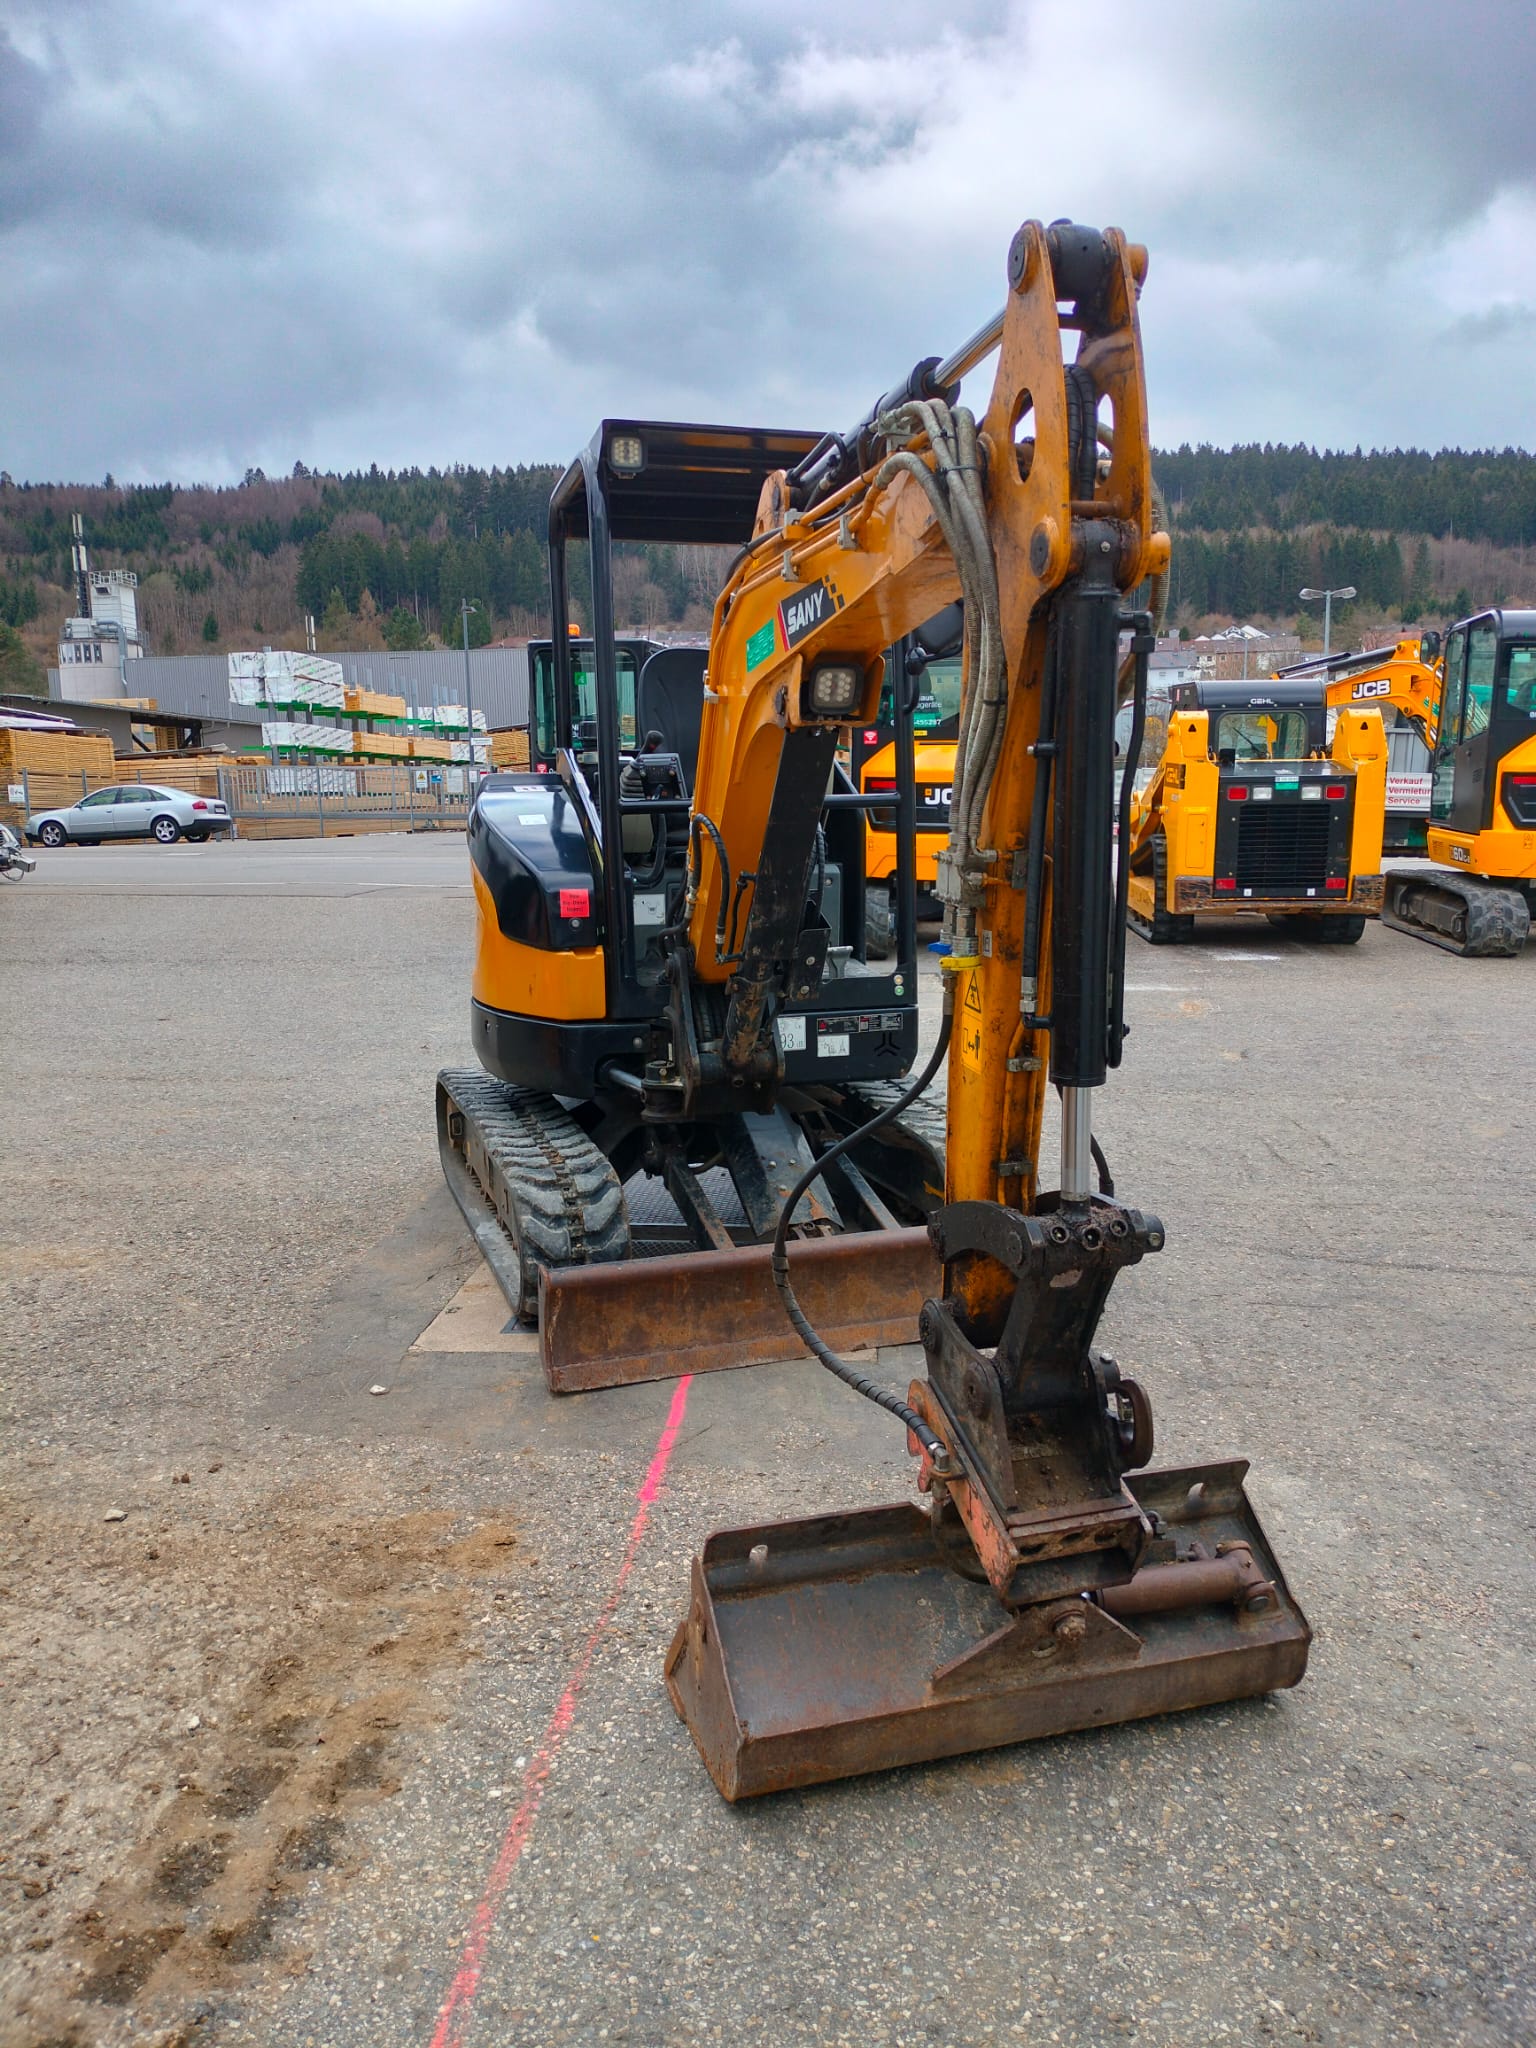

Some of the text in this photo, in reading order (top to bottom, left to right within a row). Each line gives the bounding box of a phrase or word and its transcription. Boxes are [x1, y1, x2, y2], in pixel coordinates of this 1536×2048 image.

[787, 587, 824, 635] SANY
[1352, 680, 1391, 699] JCB
[1389, 776, 1424, 785] Verkauf
[925, 787, 952, 805] JC
[1388, 796, 1421, 805] Service
